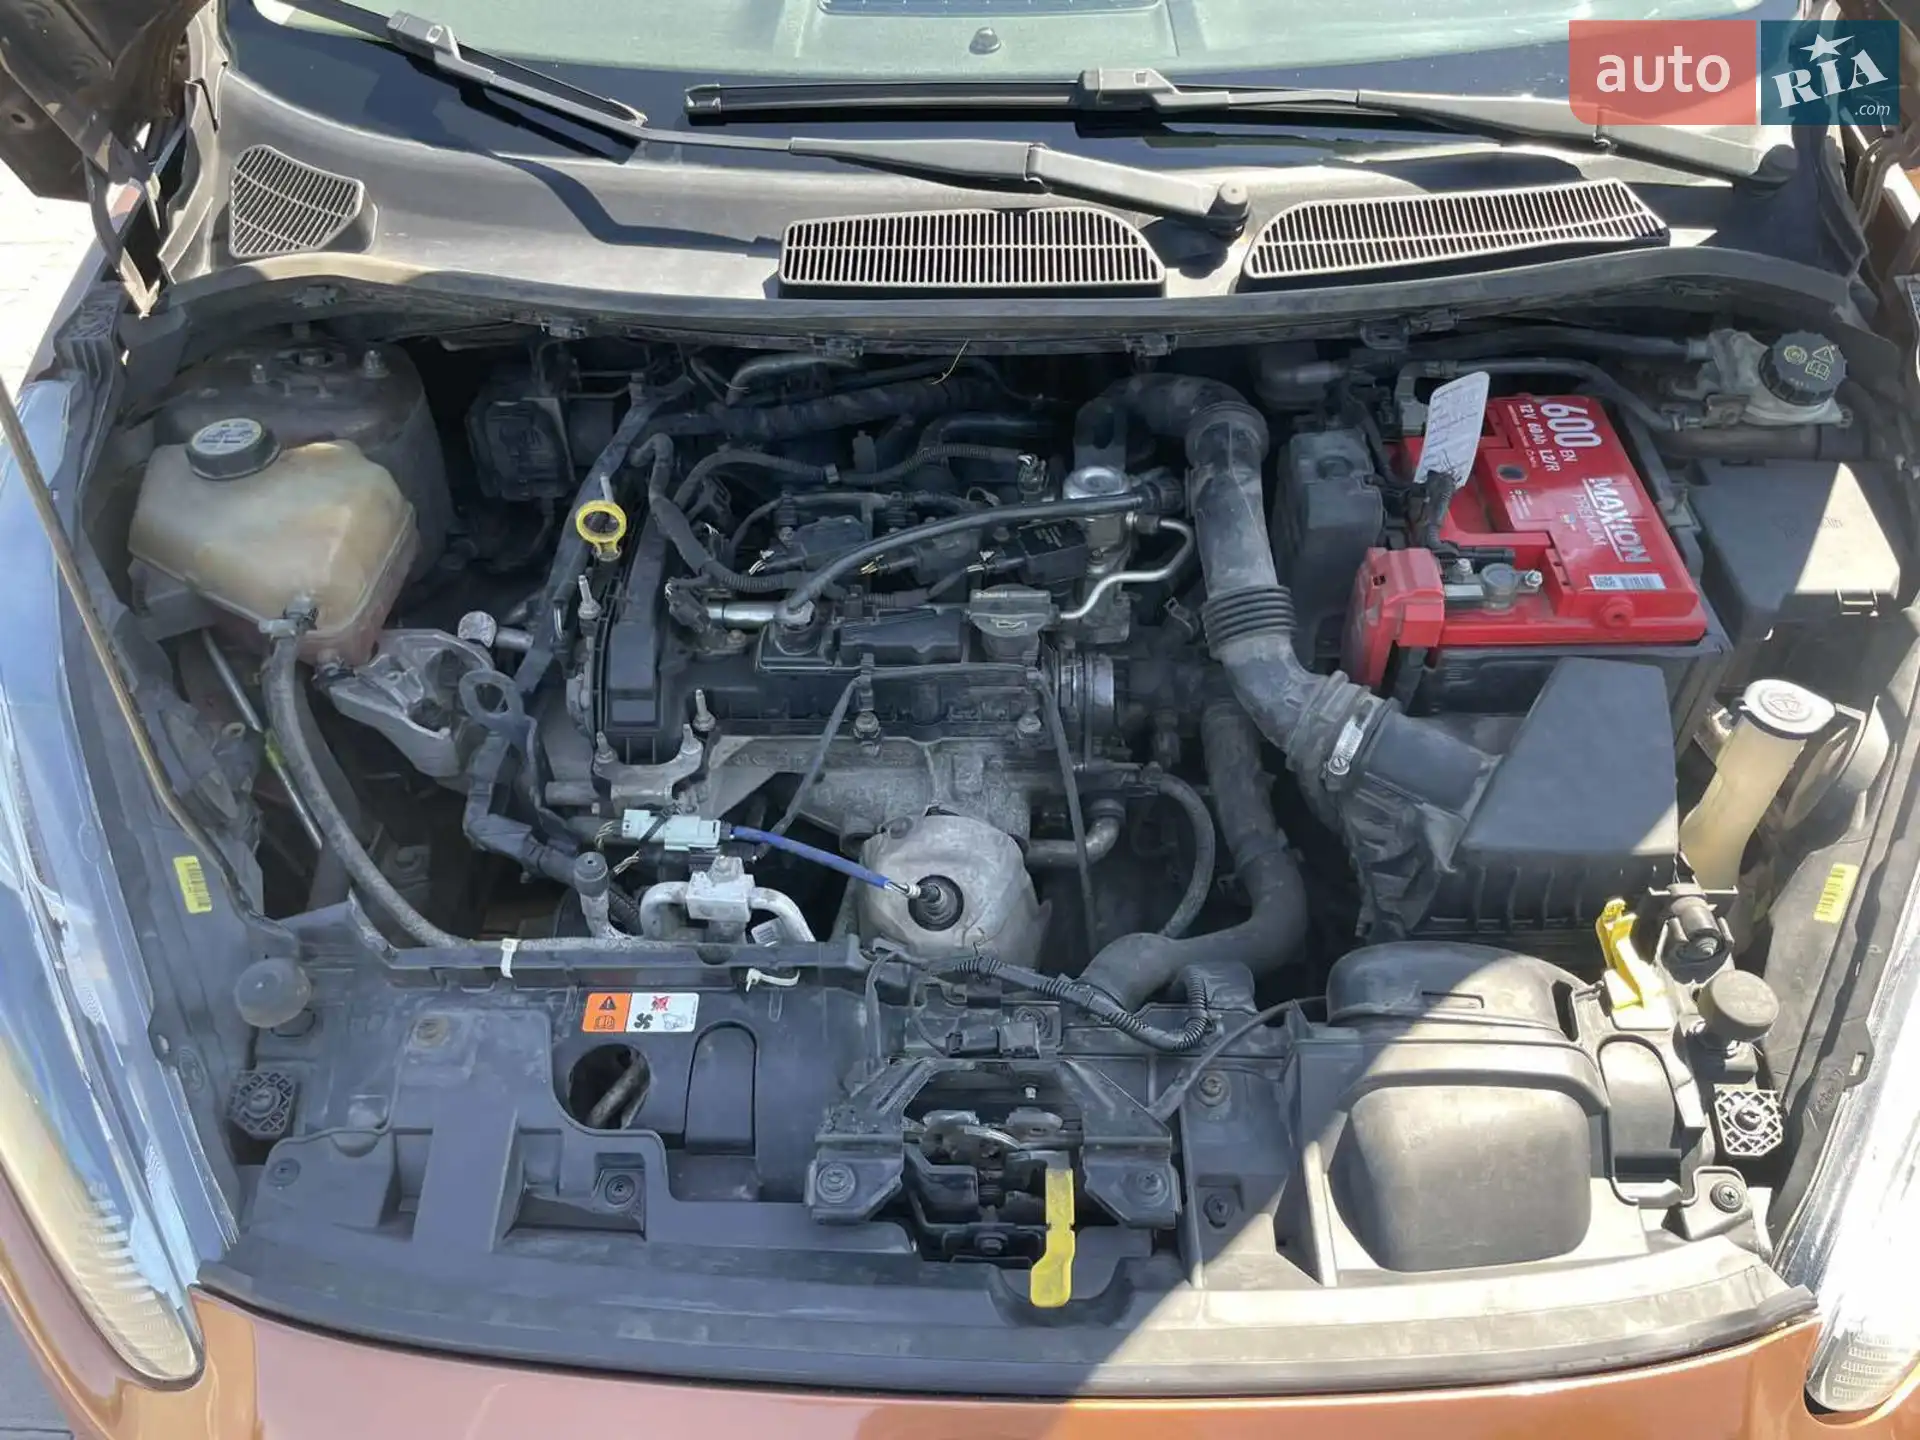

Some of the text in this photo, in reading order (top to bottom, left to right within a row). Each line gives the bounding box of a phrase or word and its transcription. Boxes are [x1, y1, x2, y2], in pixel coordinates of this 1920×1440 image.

[1520, 404, 1537, 420] 12V
[1540, 403, 1603, 462] 600 EN
[1590, 478, 1652, 562] MAXION
